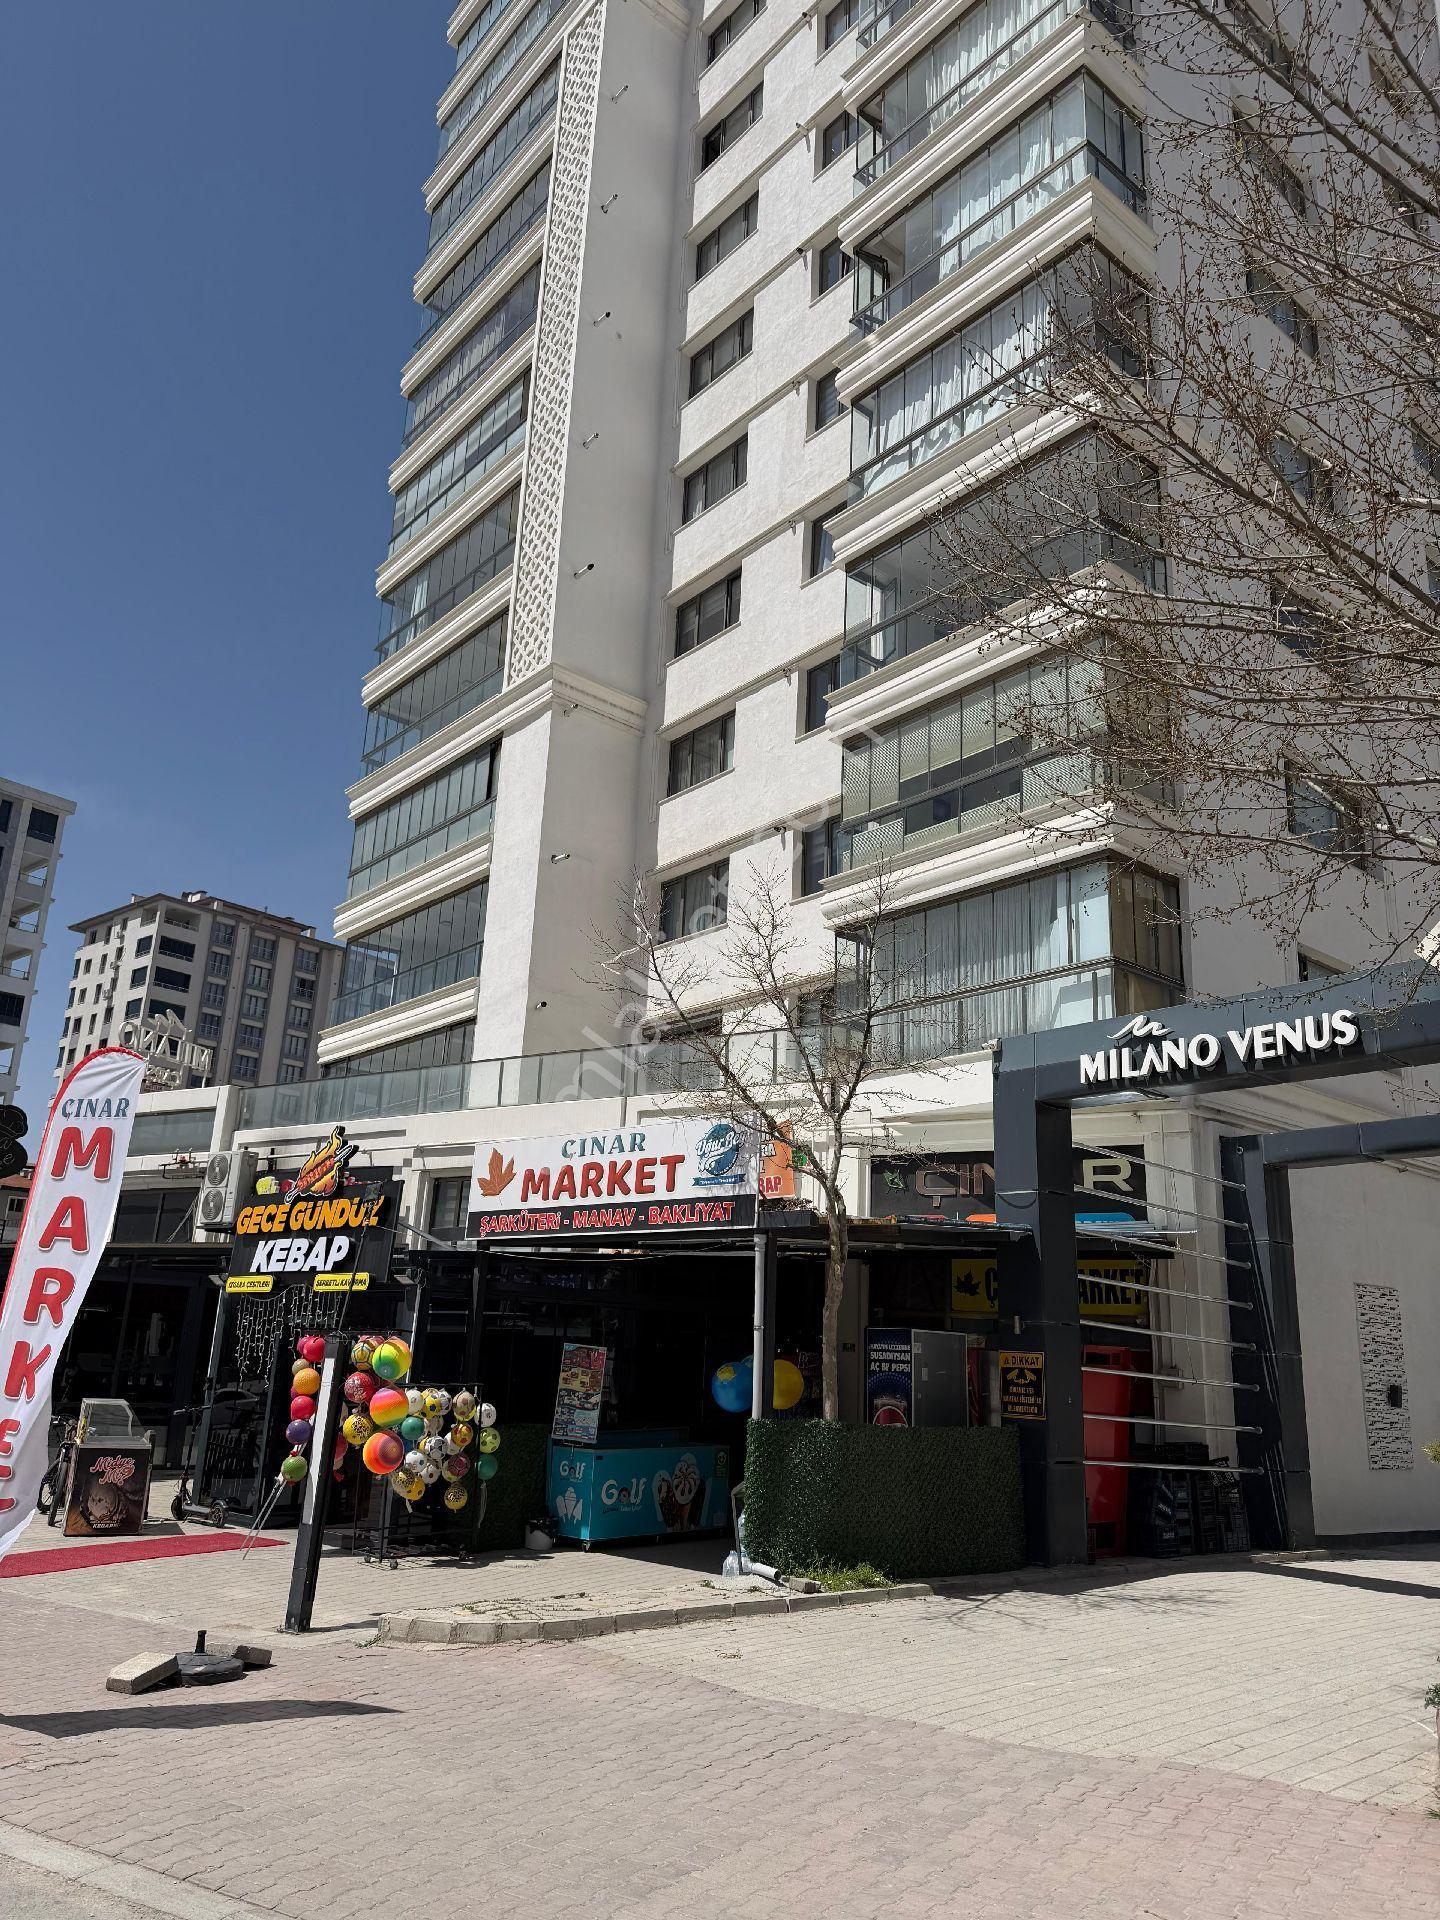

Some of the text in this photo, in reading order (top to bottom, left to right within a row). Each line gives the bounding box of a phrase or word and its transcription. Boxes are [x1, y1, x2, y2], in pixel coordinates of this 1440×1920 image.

[1079, 1009, 1360, 1085] MILANO VENUS
[561, 1131, 647, 1160] ÇINAR
[520, 1154, 686, 1203] MARKET
[915, 1158, 1135, 1208] ÇINR
[236, 1195, 383, 1235] GECE GÜNDÜZ
[573, 1207, 636, 1229] MANAV
[249, 1236, 350, 1272] KEBAP
[1078, 1268, 1144, 1304] ARKET
[0, 1126, 113, 1512] MARKE
[1011, 1355, 1040, 1366] DİKKAT
[602, 1478, 648, 1505] Golf
